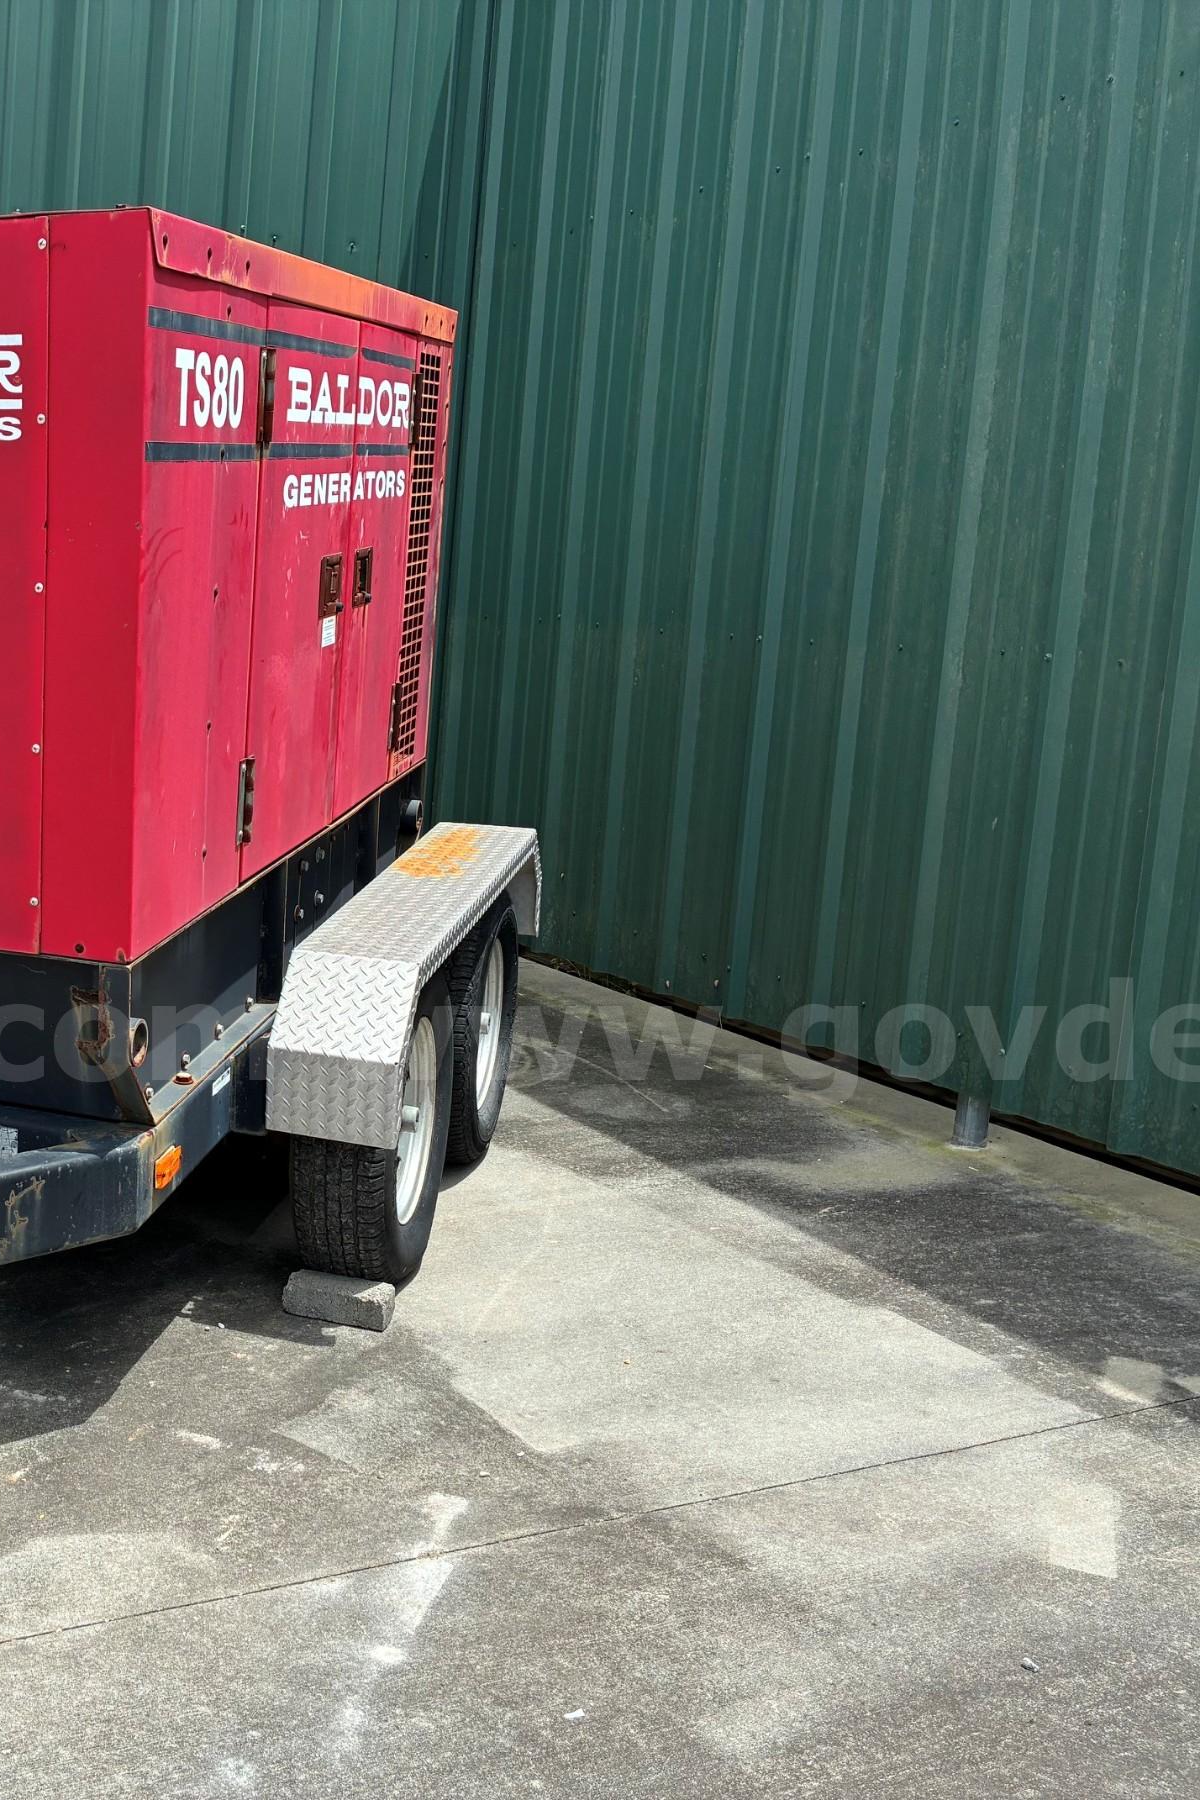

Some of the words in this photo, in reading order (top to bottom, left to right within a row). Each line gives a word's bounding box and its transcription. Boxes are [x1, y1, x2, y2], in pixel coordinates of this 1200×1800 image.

[175, 347, 245, 430] TS80
[286, 366, 414, 431] BALDOR
[282, 470, 406, 508] GENERATORS
